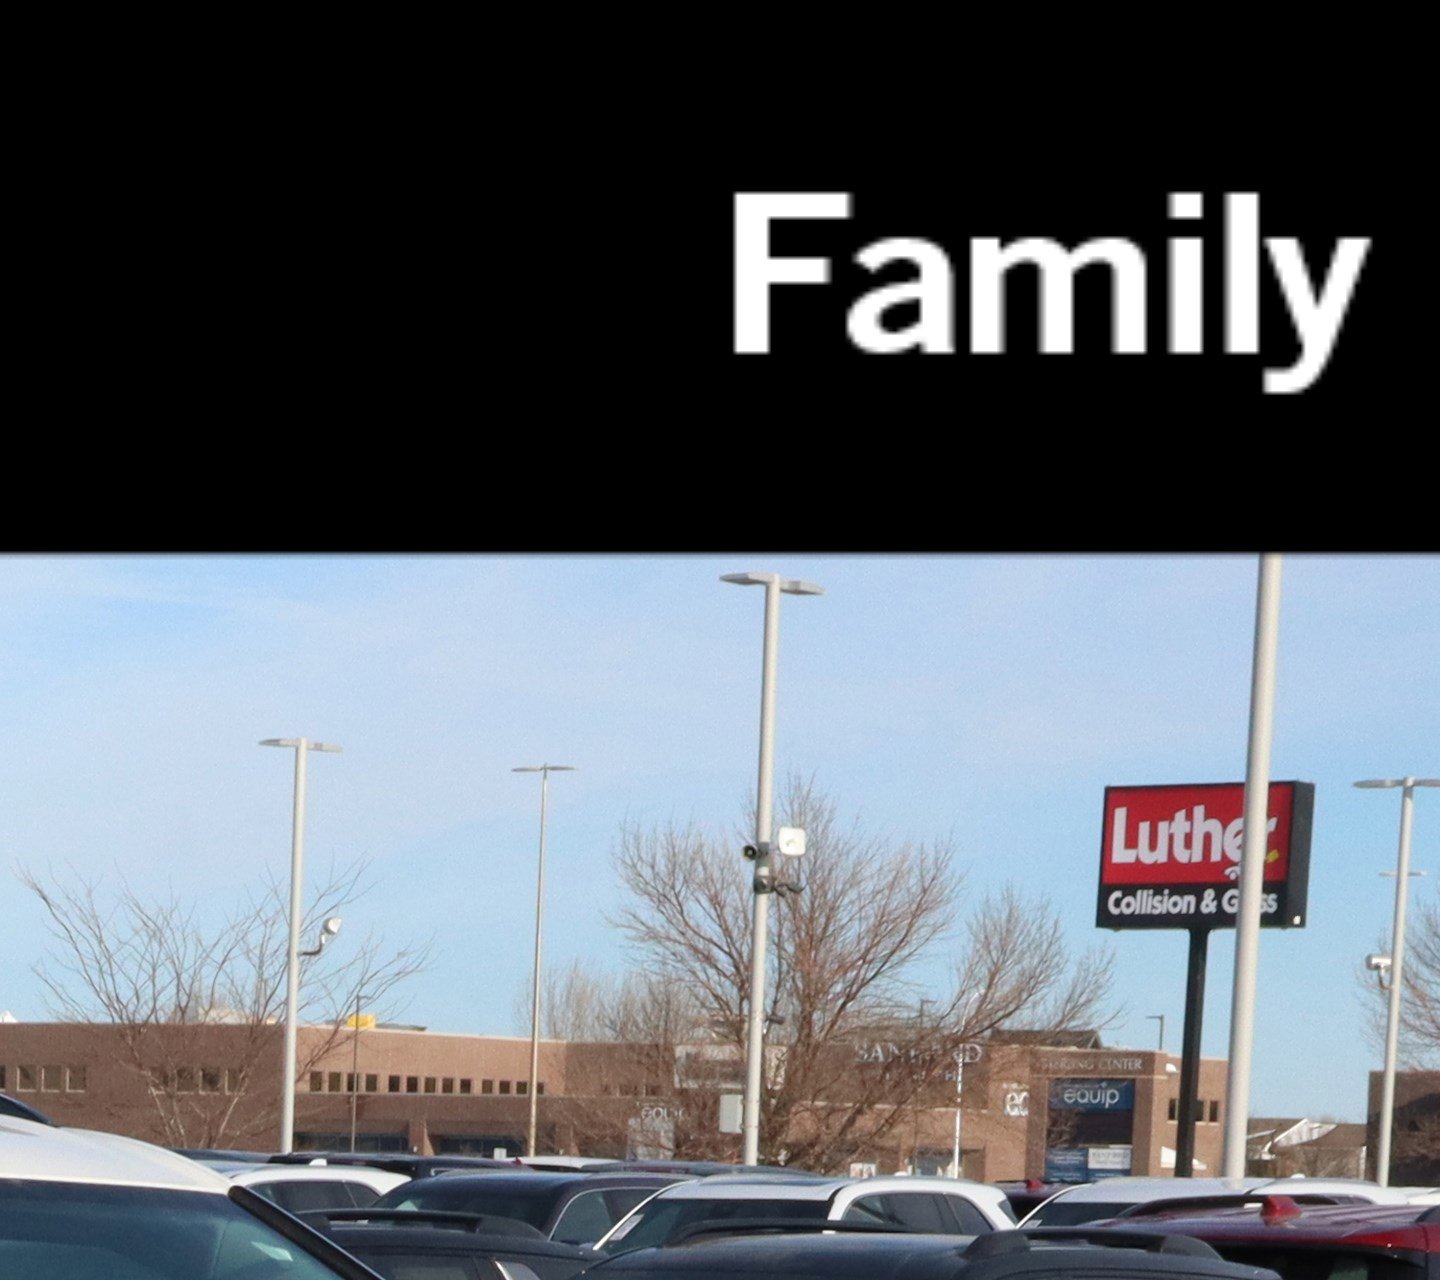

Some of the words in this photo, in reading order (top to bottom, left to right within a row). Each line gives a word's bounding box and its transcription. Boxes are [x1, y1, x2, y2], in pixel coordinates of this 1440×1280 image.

[1107, 888, 1196, 916] Collision
[1200, 888, 1217, 914] &
[1222, 891, 1279, 915] Gss
[1063, 1088, 1120, 1109] equip
